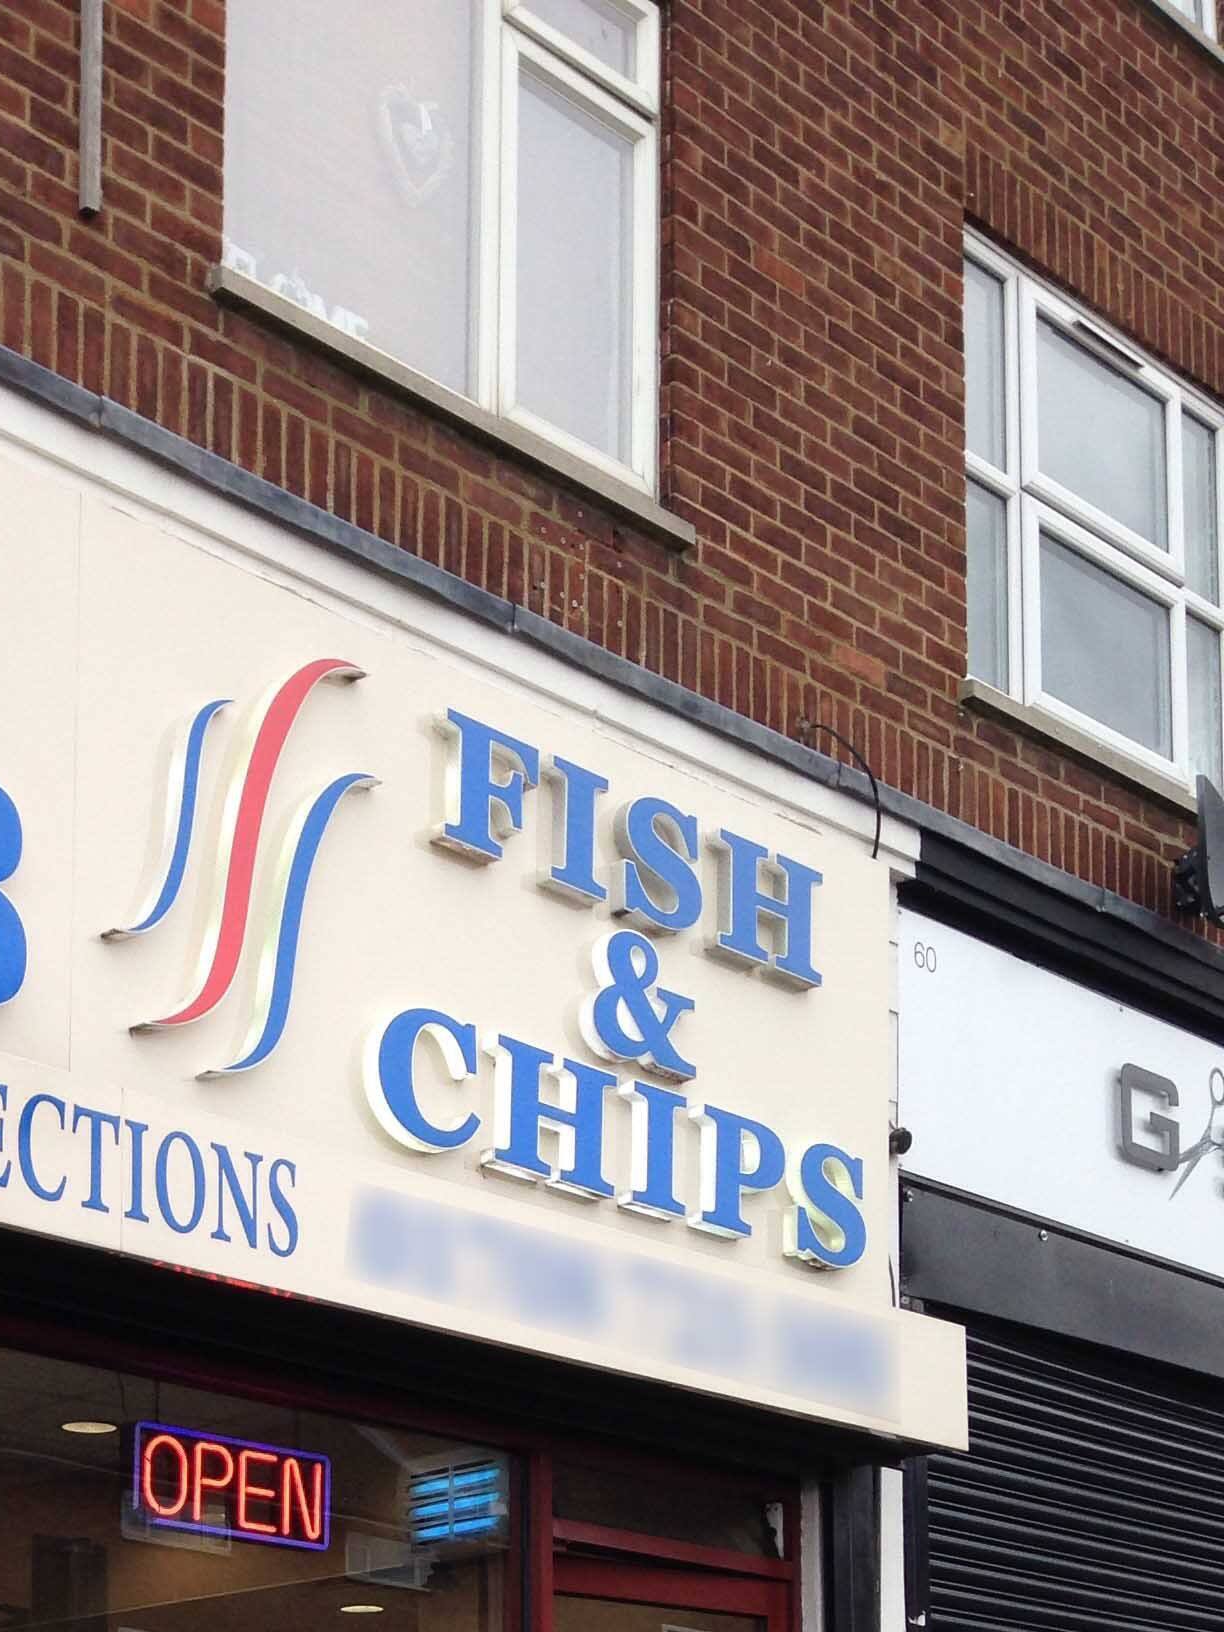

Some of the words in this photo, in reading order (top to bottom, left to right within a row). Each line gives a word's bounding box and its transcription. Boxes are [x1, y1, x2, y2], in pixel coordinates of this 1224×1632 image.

[431, 708, 823, 991] FISH
[580, 929, 696, 1083] &
[914, 941, 937, 973] 60
[363, 1008, 866, 1270] CHIPS
[143, 1434, 322, 1540] OPEN
